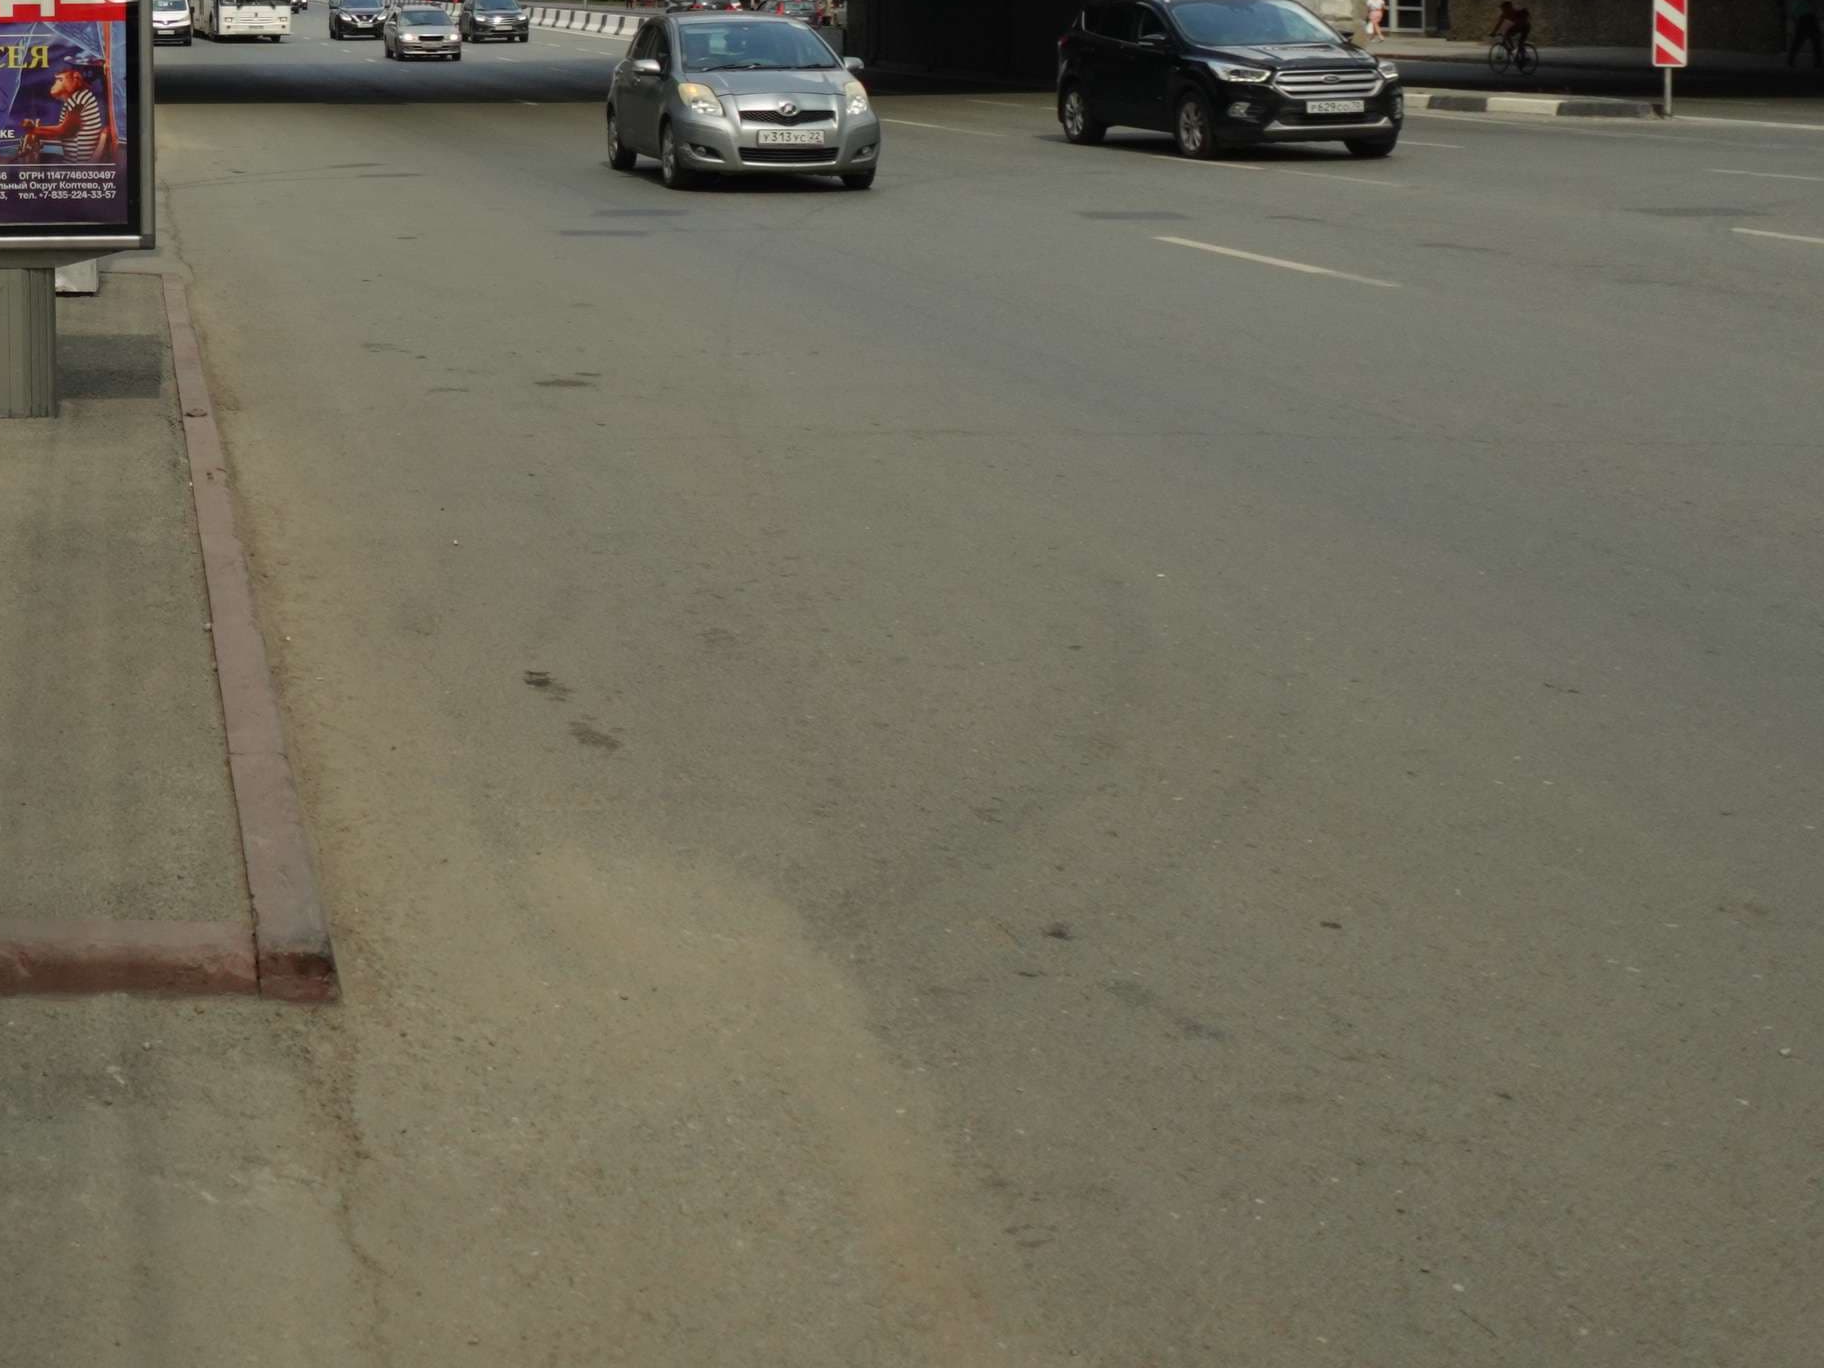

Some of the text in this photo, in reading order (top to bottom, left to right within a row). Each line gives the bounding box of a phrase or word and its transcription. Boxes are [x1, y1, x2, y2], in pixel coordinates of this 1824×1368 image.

[19, 171, 44, 180] ОГРН
[29, 181, 56, 191] Округ
[59, 181, 100, 190] Коптево,
[102, 182, 116, 191] ул.
[0, 191, 8, 201] 3,
[18, 192, 36, 200] тел.
